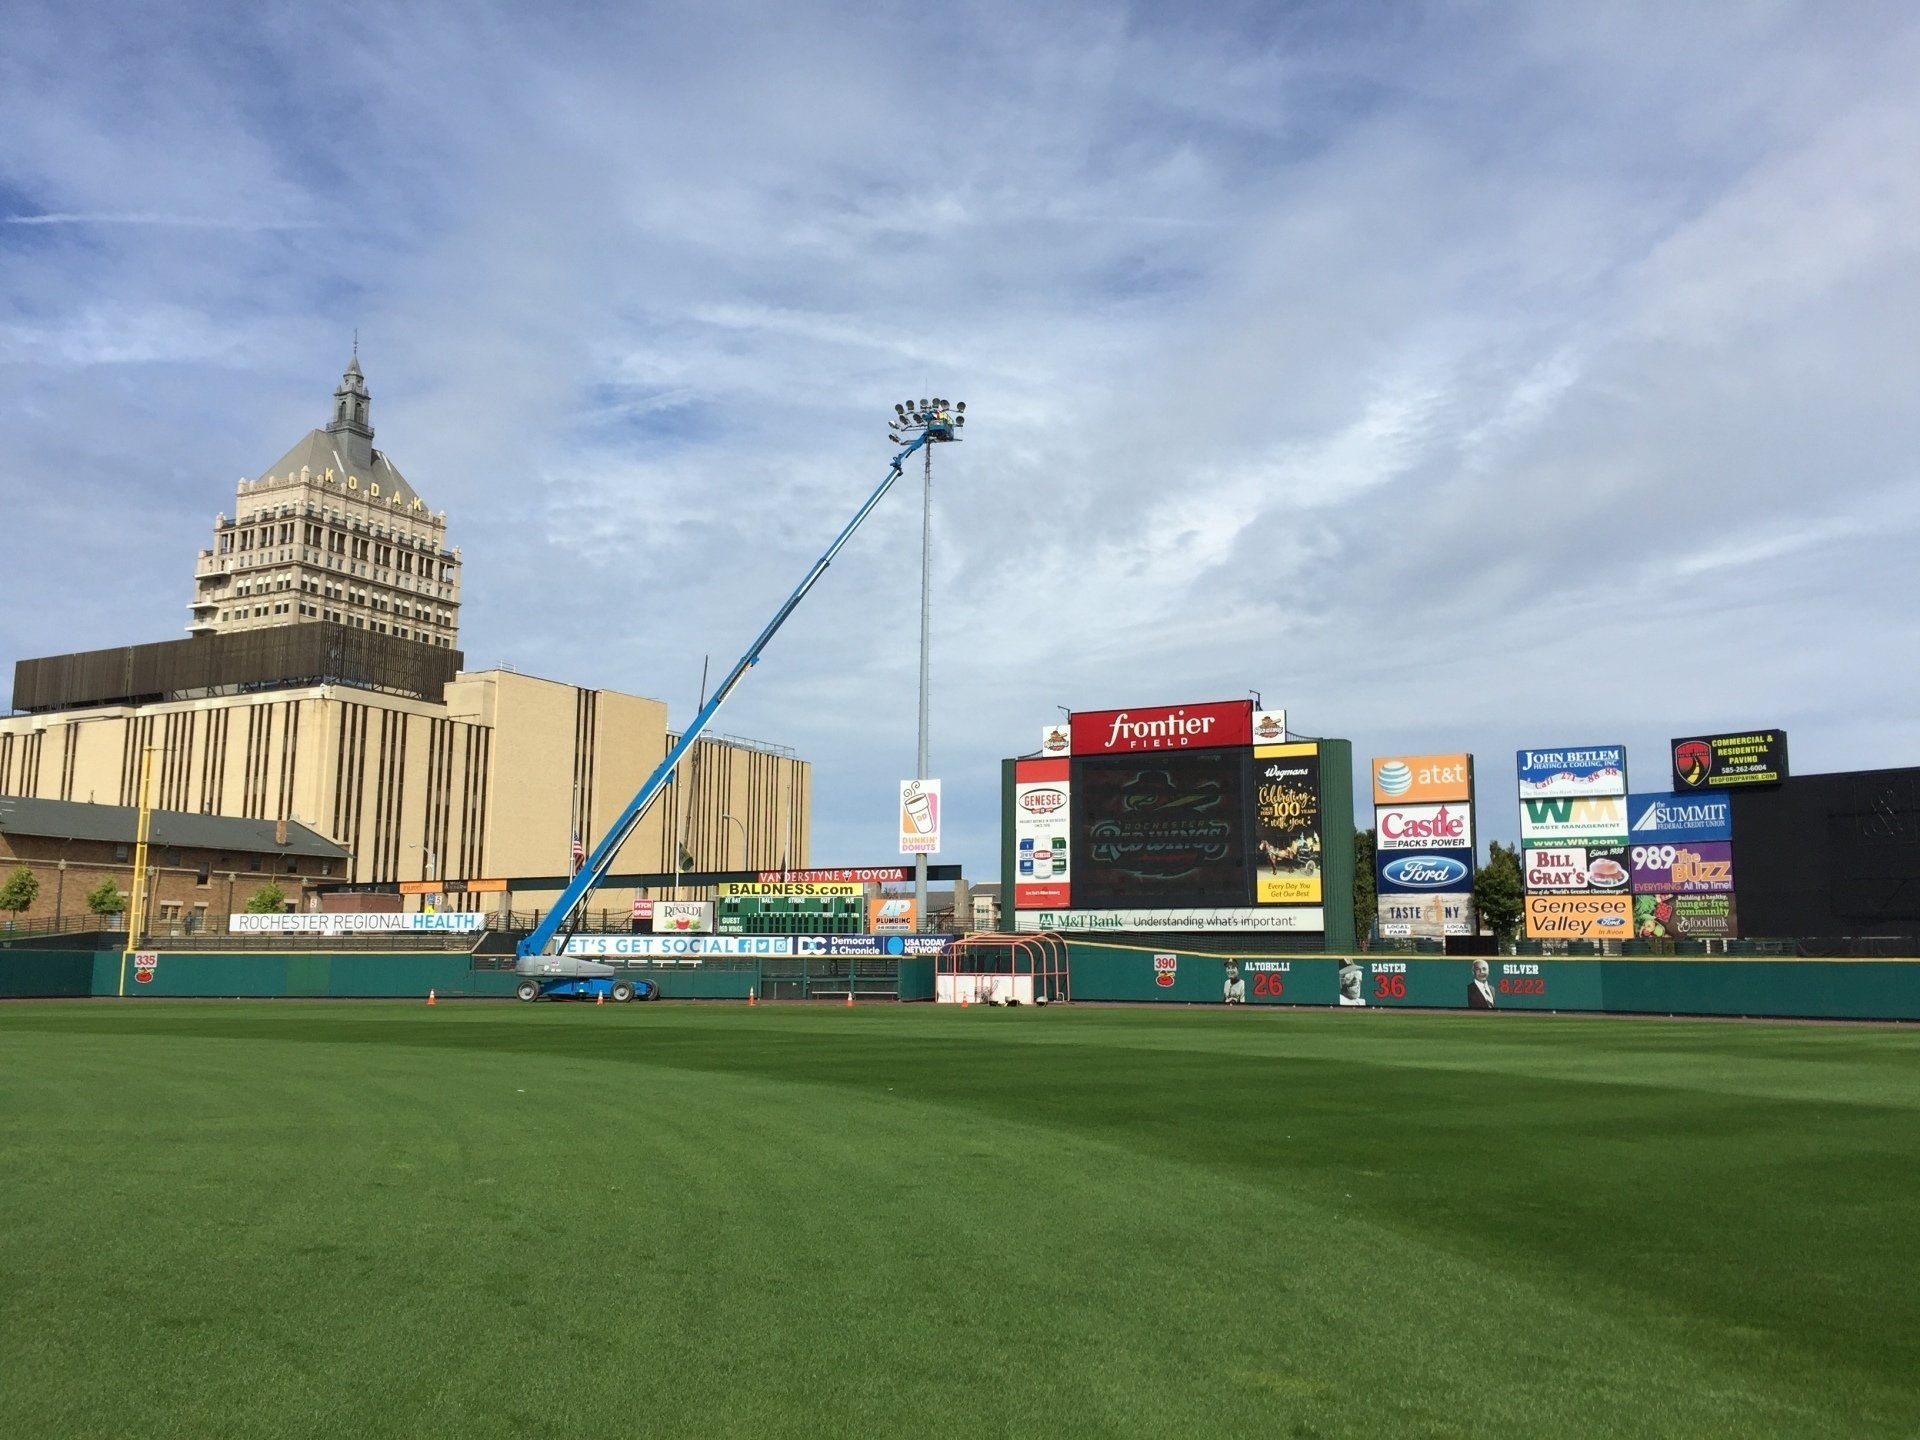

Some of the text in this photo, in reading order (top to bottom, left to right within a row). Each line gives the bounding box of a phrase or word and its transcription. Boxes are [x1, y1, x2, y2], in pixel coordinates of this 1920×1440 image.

[325, 467, 422, 512] KODAK
[1105, 710, 1215, 747] frontier
[1130, 737, 1188, 748] FIELD
[1711, 735, 1773, 748] COMMERCIAL &
[1717, 744, 1769, 756] RESIDENTIAL
[1523, 749, 1620, 771] JOHN BETLEM
[1729, 755, 1758, 765] PAVING
[1264, 764, 1309, 781] Wegmans
[1418, 763, 1465, 785] at&t
[1721, 764, 1767, 774] 585-262-6004
[1534, 767, 1618, 790] Call 271 88 88
[1024, 794, 1062, 806] GENESEE
[1259, 784, 1311, 808] Celebrating
[1272, 802, 1301, 817] 100
[1525, 797, 1620, 824] WM
[1656, 803, 1727, 823] SUMMIT
[1381, 804, 1464, 840] Castle
[902, 844, 936, 852] DONUTS
[1398, 839, 1465, 848] PACKS POWER
[1533, 838, 1618, 847] www.WM.com
[1536, 851, 1574, 868] BILL
[1631, 845, 1676, 871] 98.9
[1676, 848, 1701, 864] The
[760, 869, 903, 882] VANDERSTYNE TOYOTA
[1400, 861, 1450, 881] Ford
[1528, 868, 1585, 885] GRAY'S
[1671, 861, 1732, 883] BUZZ
[729, 883, 854, 895] BALDNESS.com
[1285, 882, 1298, 890] Day
[1683, 882, 1693, 890] All
[1695, 881, 1709, 890] The
[1710, 880, 1731, 890] Time!
[1270, 890, 1282, 898] Get
[877, 899, 911, 917] AP
[1531, 898, 1626, 914] Genesee
[1676, 900, 1729, 909] hunger-free
[664, 905, 702, 918] RINALDI
[1390, 906, 1459, 919] TASTE NY
[1676, 908, 1729, 917] community
[239, 914, 475, 930] ROCHESTER REGIONAL HEALTH
[1058, 914, 1296, 928] M&T Bank Understanding what's important.
[1533, 916, 1592, 935] Valley
[1690, 917, 1729, 928] foodlink
[615, 939, 653, 953] GET
[662, 939, 733, 953] SOCIAL
[797, 936, 828, 955] DC
[831, 936, 875, 945] Democrat
[904, 938, 946, 946] USA TODAY
[831, 946, 880, 955] & Chronicle
[904, 946, 943, 954] NETWORK
[136, 955, 156, 966] 335
[1155, 958, 1176, 969] 390
[1244, 962, 1290, 971] ALTOBELLI
[1371, 963, 1407, 973] EASTER
[1503, 964, 1539, 975] SILVER
[1252, 972, 1284, 997] 26
[1373, 974, 1407, 1000] 36
